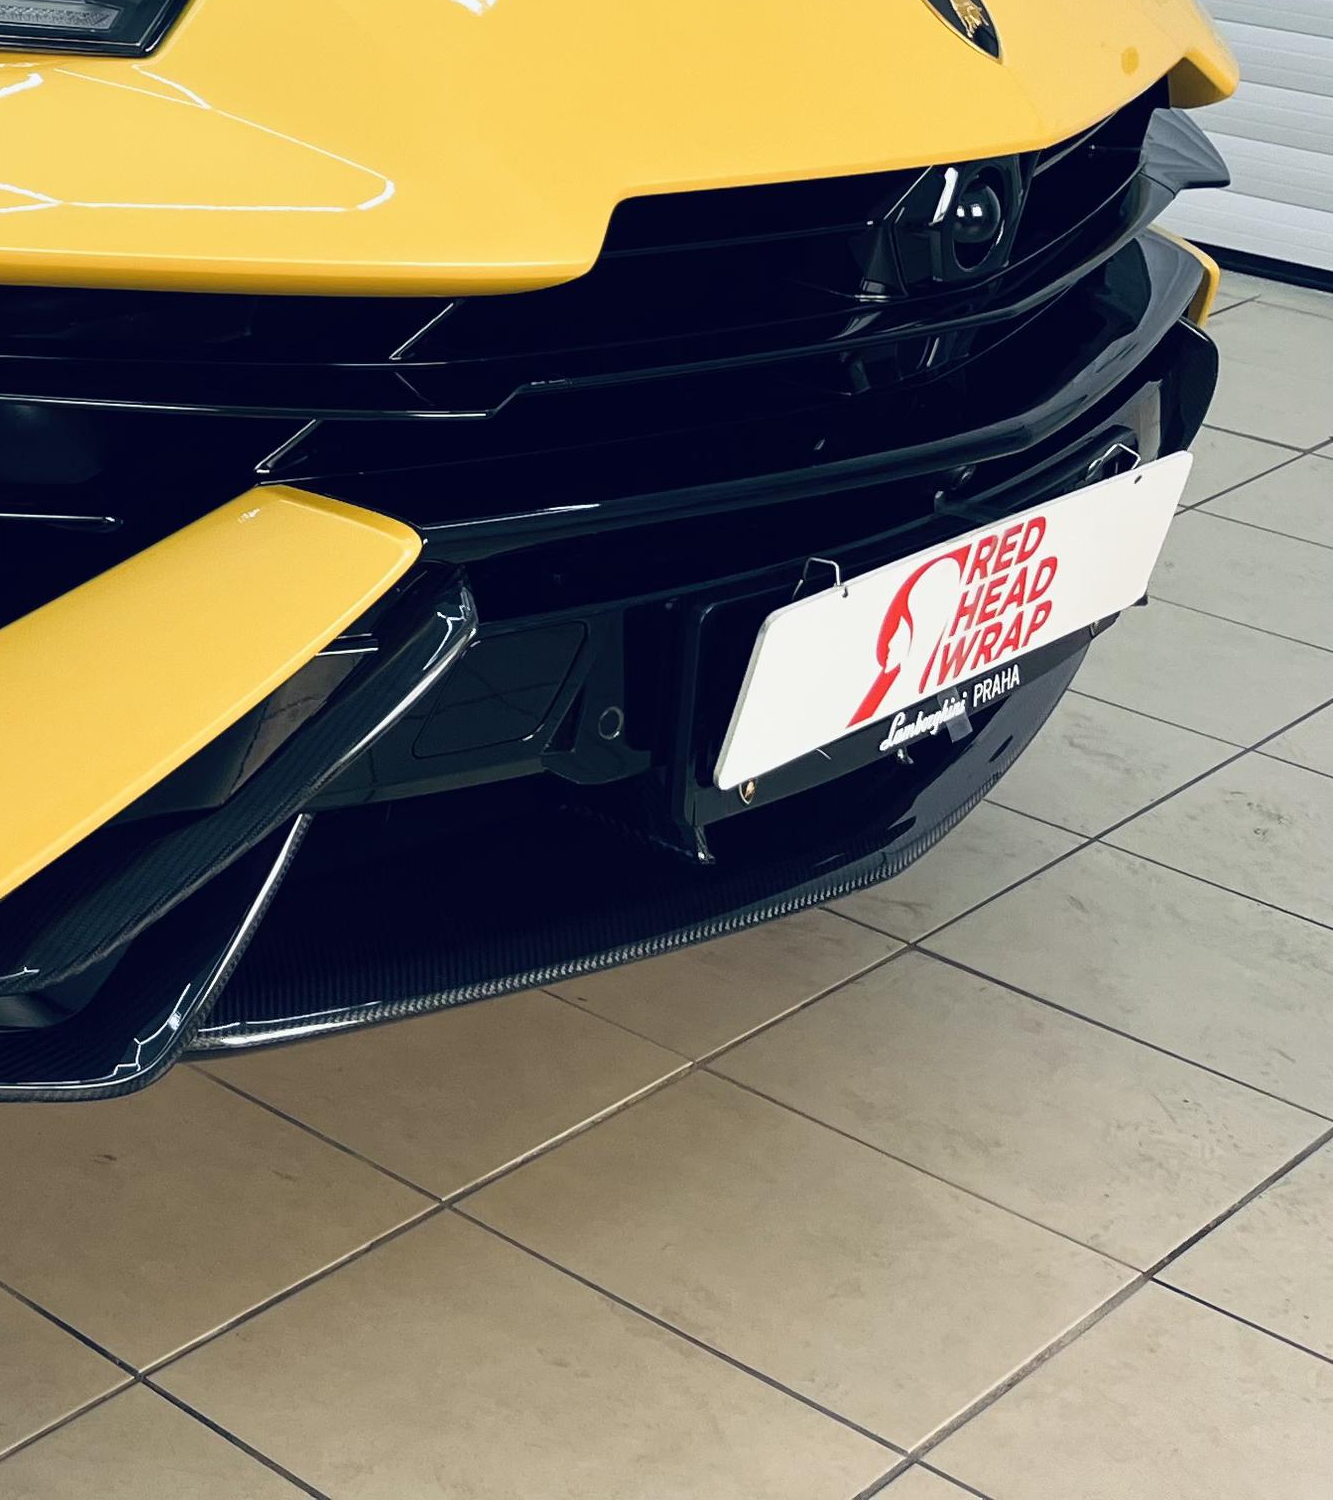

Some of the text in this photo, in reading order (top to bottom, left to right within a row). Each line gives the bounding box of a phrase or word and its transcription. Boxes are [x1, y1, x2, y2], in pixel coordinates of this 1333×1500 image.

[966, 515, 1047, 585] RED
[949, 555, 1059, 637] HEAD
[937, 599, 1053, 686] WRAP
[879, 664, 1020, 751] Lamborghini PRAHA
